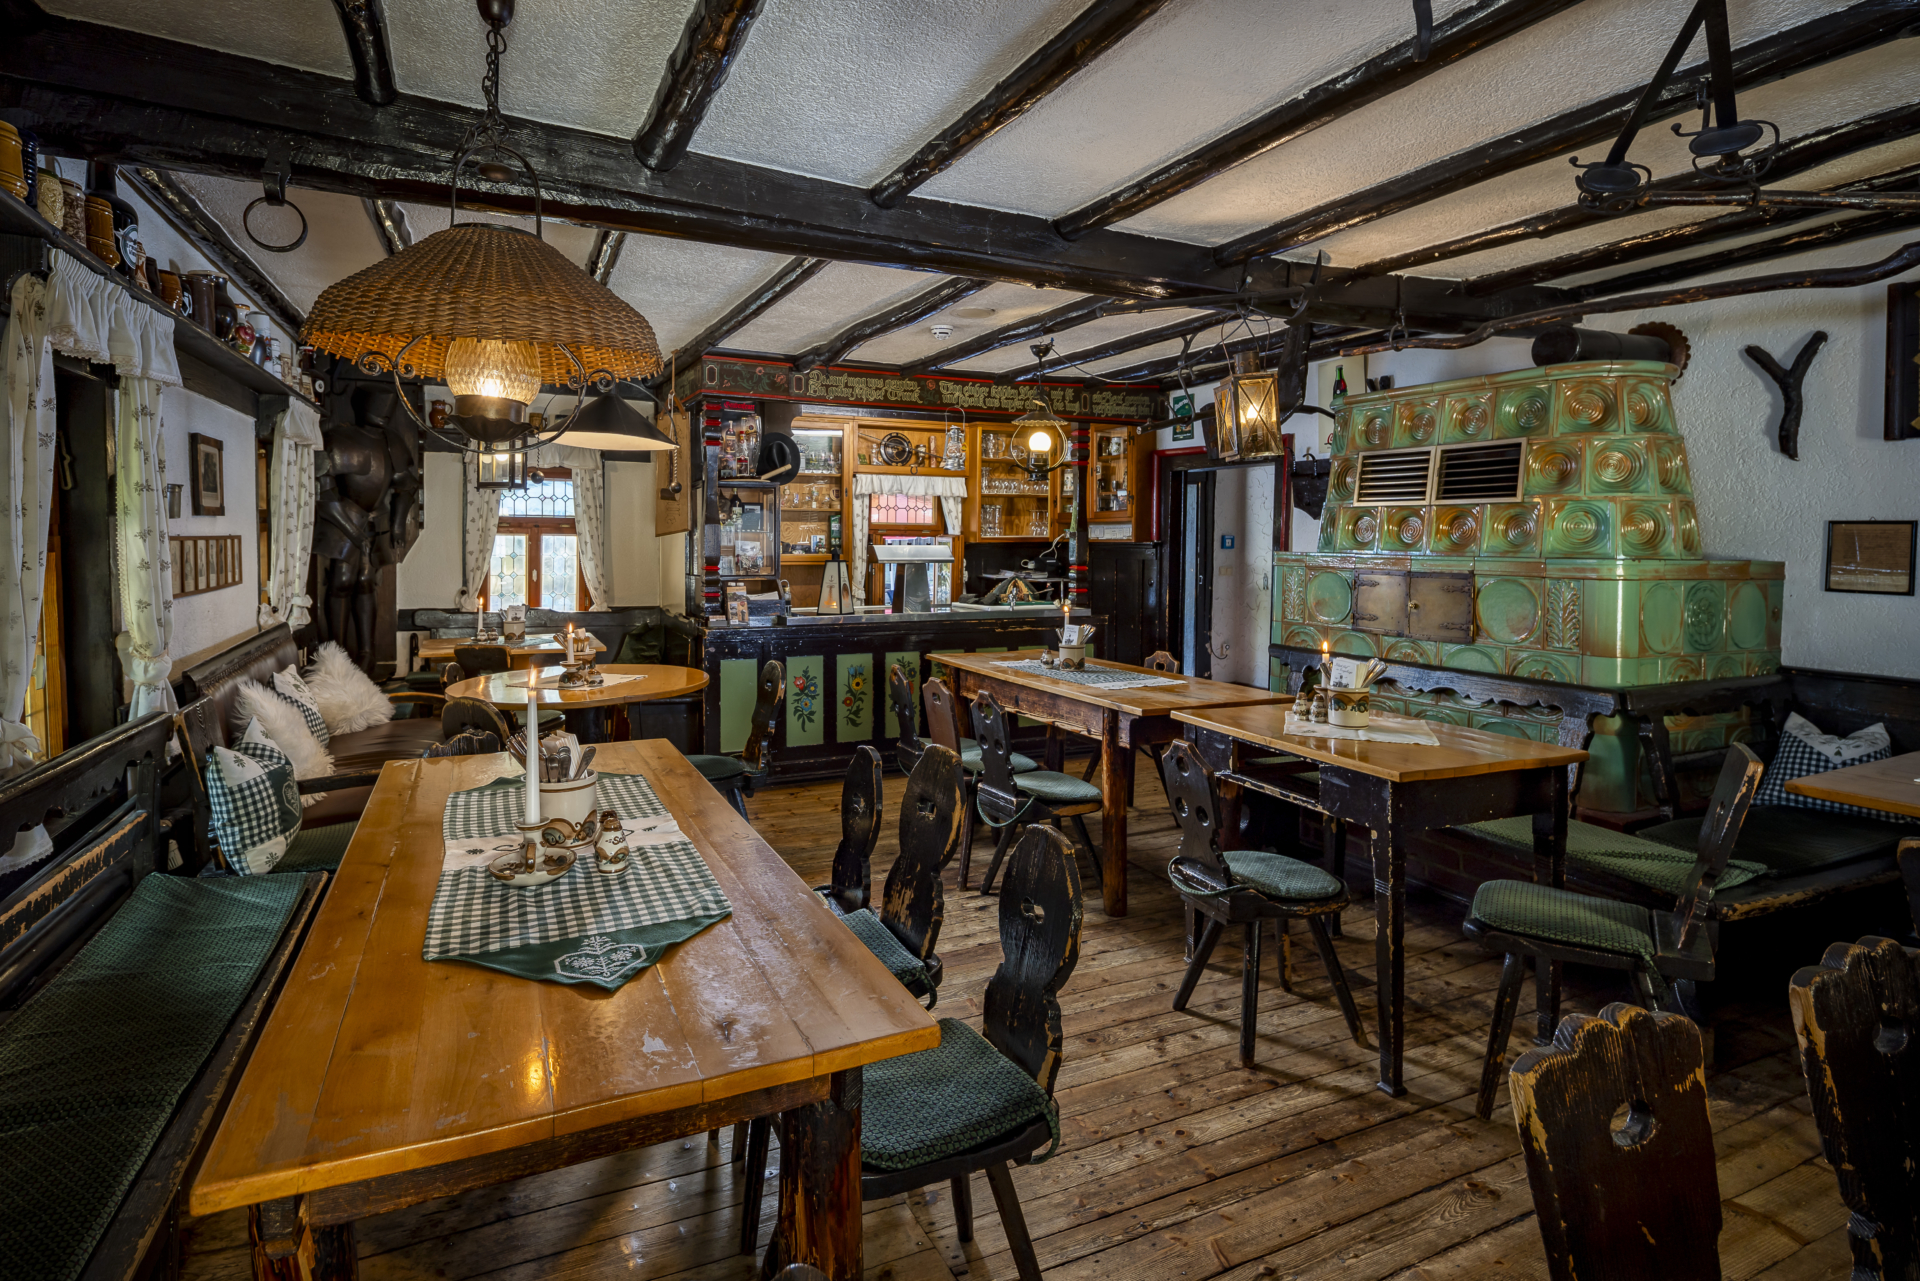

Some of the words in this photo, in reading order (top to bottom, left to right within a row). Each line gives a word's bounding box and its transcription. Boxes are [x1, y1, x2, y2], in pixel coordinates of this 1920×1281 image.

[847, 376, 867, 388] mag
[867, 377, 884, 389] uns
[807, 379, 827, 396] Ein
[826, 386, 852, 400] guter
[887, 386, 923, 404] Trunk
[985, 397, 1000, 407] uns
